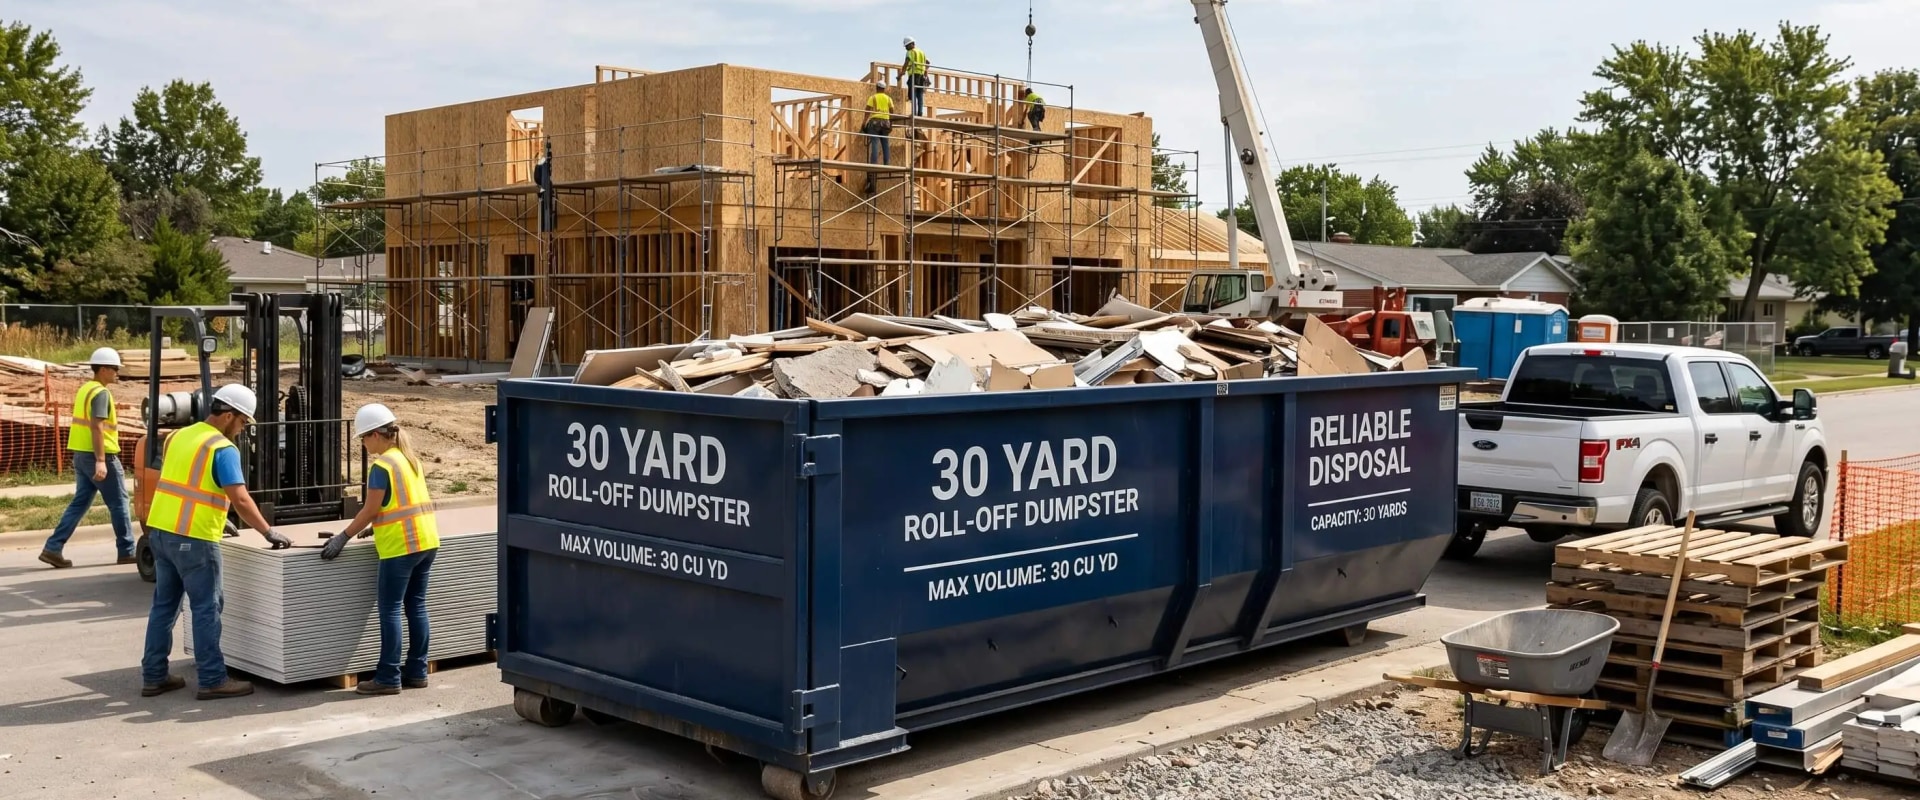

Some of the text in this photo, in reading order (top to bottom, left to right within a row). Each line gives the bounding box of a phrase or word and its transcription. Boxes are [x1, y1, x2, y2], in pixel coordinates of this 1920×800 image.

[1310, 408, 1412, 448] RELIABLE
[1616, 437, 1640, 450] FX4
[567, 422, 726, 485] 30 YARD
[932, 435, 1117, 500] 30 YARD
[1309, 446, 1411, 486] DISPOSAL
[548, 474, 750, 527] ROLL-OFF DUMPSTER
[904, 488, 1139, 542] ROLL-OFF DUMPSTER
[1311, 501, 1407, 531] CAPACITY: 30 YARDS
[560, 533, 728, 580] MAX VOLUME: 30 CU YD
[928, 552, 1118, 601] MAX VOLUME: 30 CU YD
